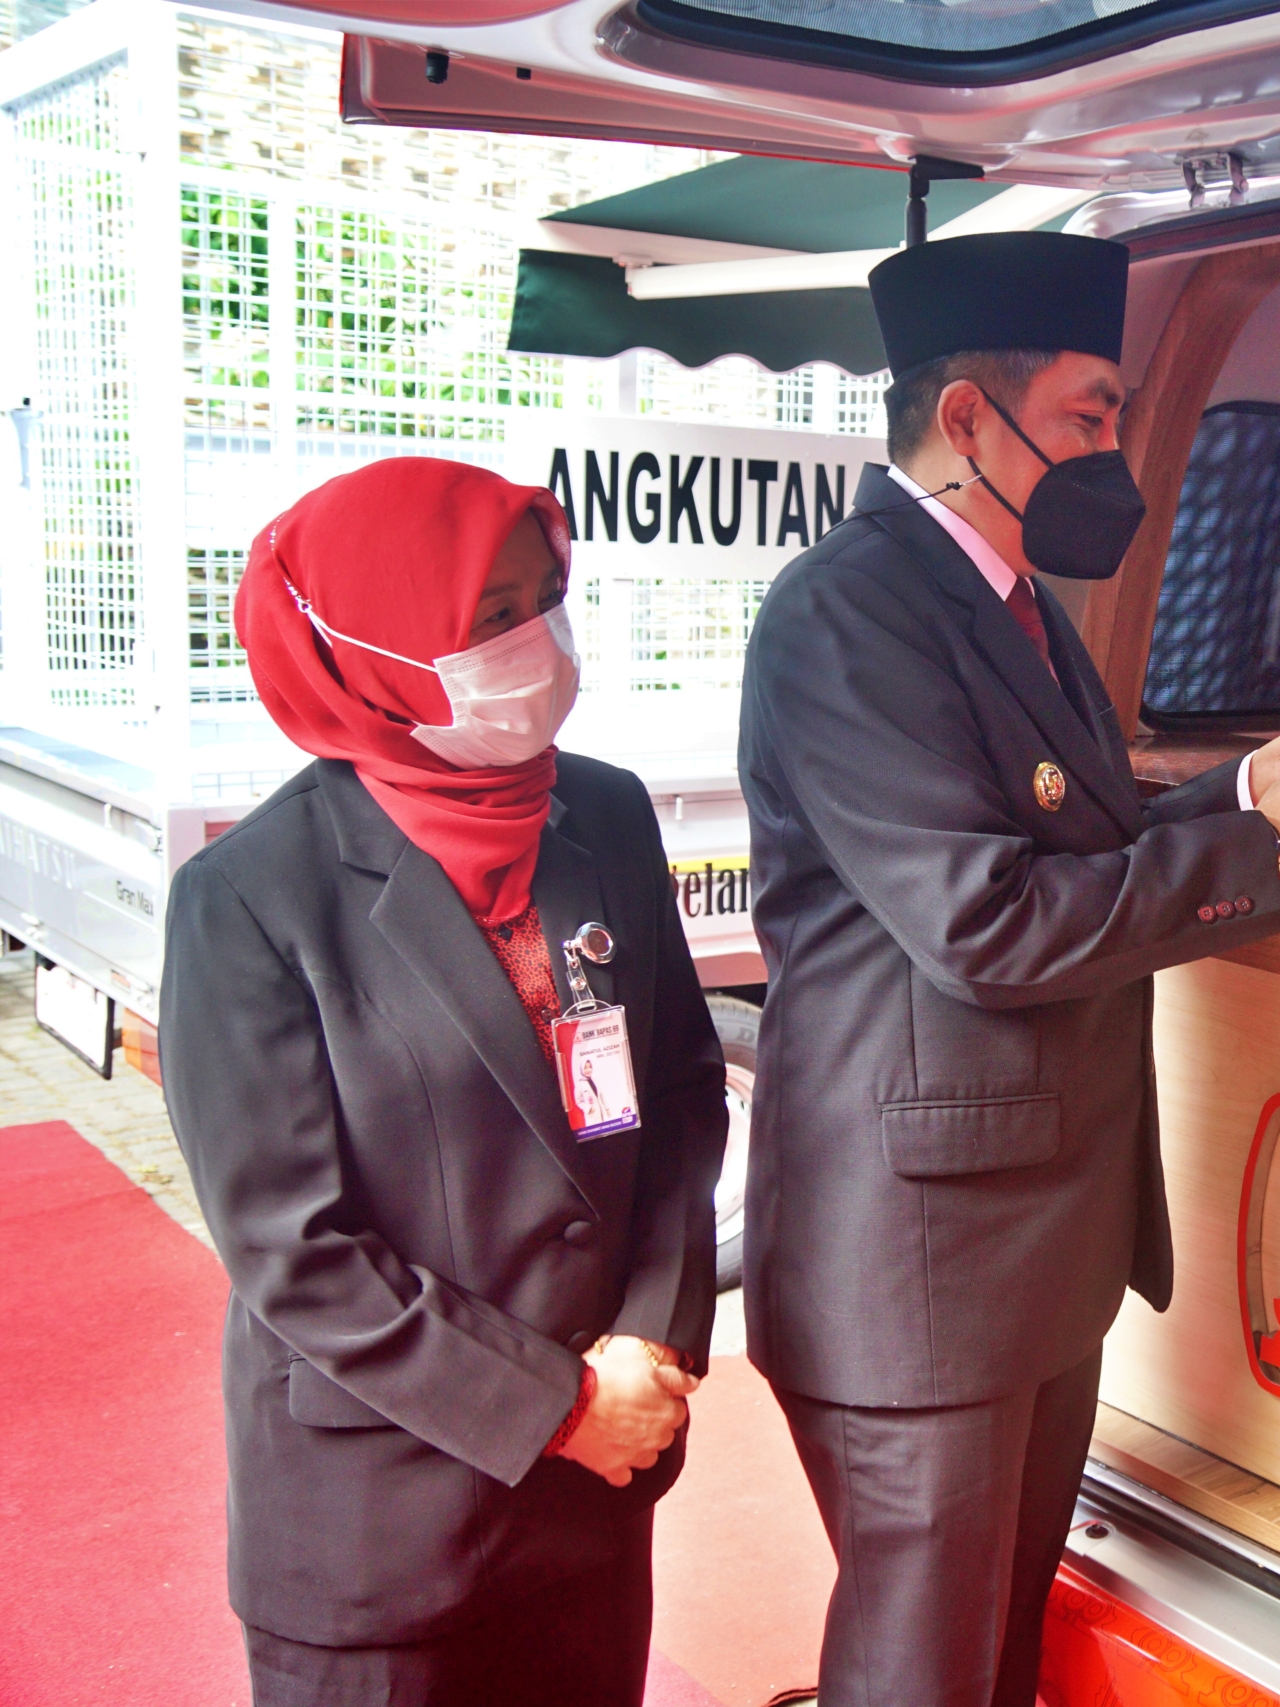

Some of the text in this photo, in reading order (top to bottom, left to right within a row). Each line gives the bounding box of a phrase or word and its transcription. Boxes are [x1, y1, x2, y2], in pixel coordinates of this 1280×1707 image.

[547, 447, 846, 548] ANGKUTAN
[582, 1029, 595, 1039] BANK
[596, 1026, 612, 1036] BAPAS
